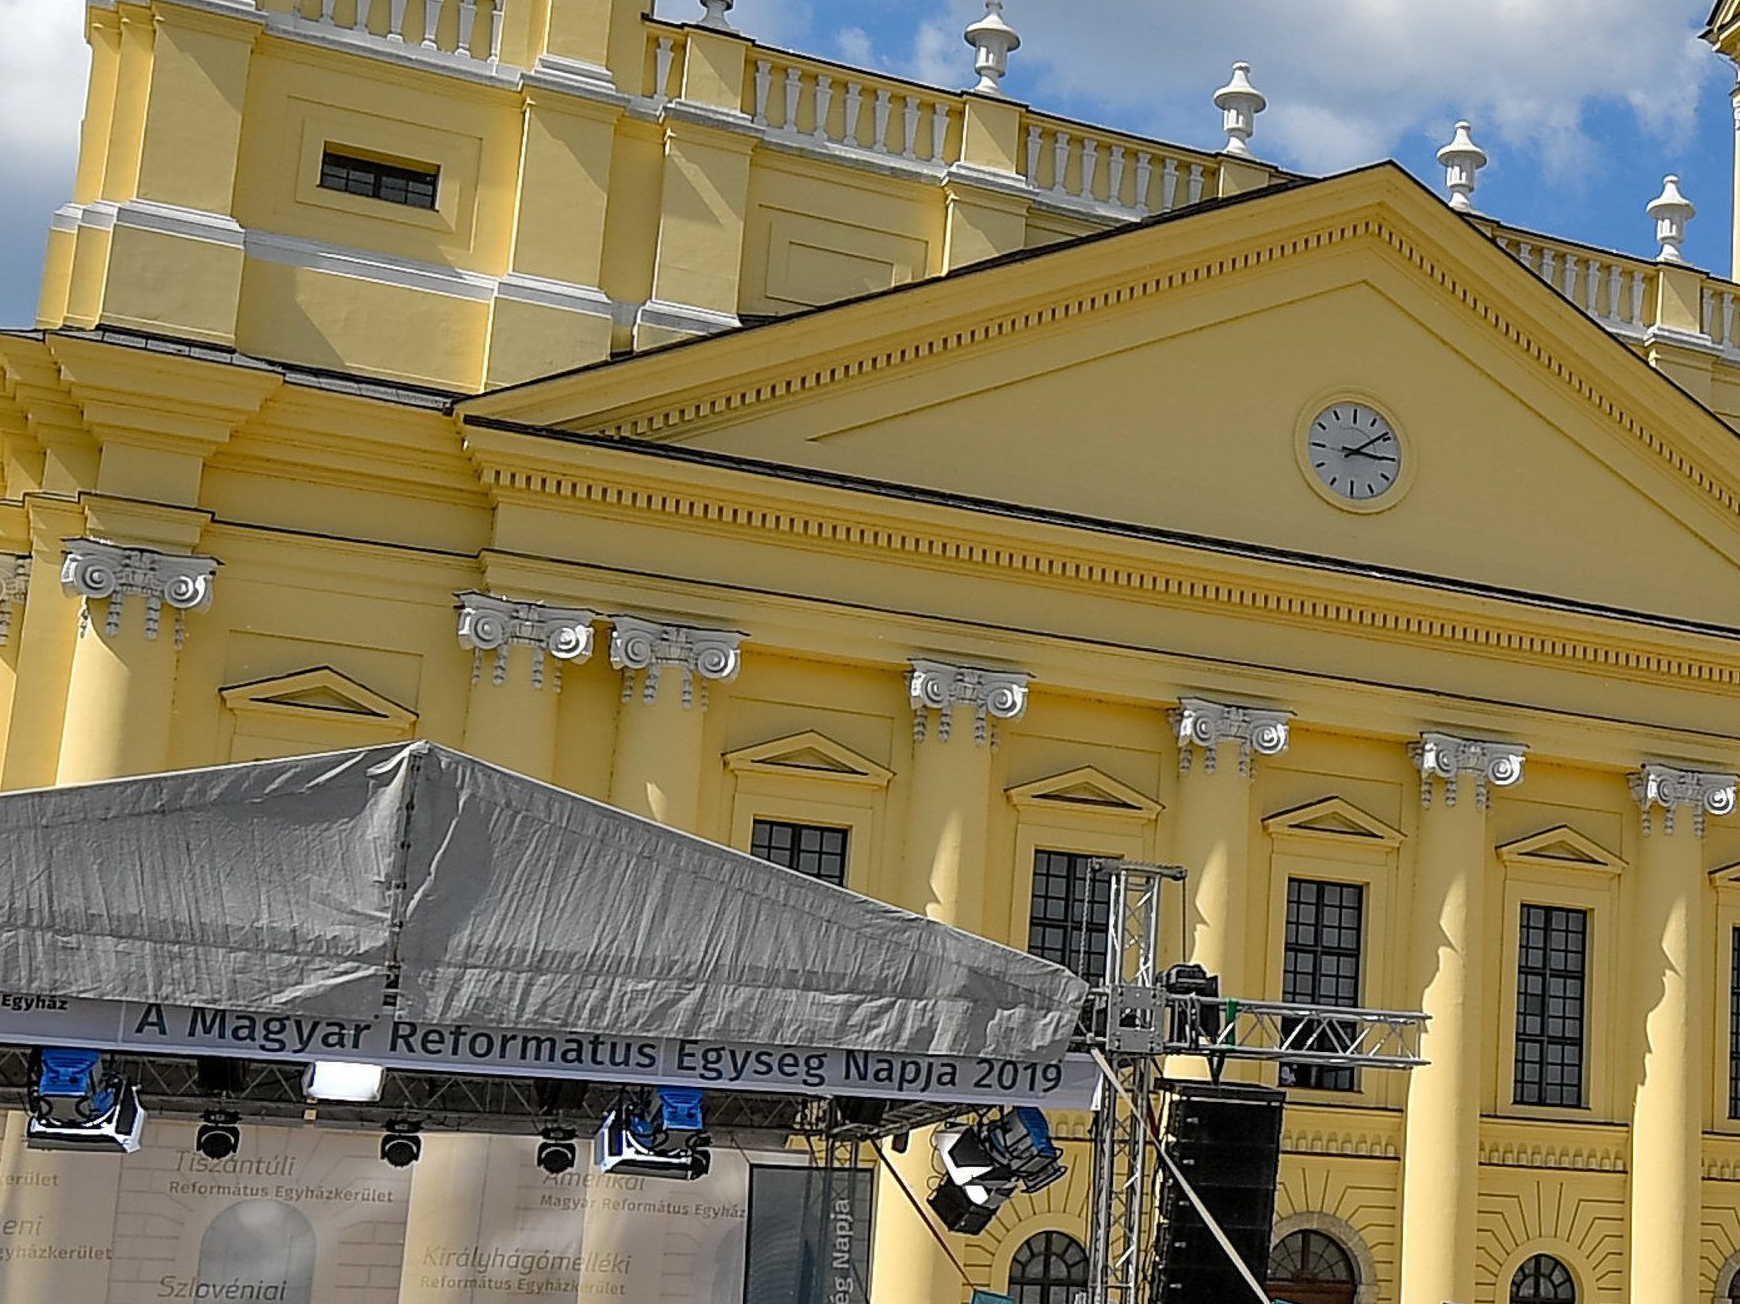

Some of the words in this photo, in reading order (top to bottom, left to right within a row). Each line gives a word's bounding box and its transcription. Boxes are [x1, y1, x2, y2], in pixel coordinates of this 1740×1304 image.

[1, 992, 69, 1012] Egyház
[134, 1006, 168, 1036] A
[186, 1006, 372, 1054] Magyar
[842, 1049, 959, 1094] Napja
[972, 1057, 1063, 1094] 2019
[174, 1149, 296, 1176] Tiszántúli
[168, 1180, 269, 1198] Református
[274, 1184, 394, 1204] Egyházkerület
[539, 1194, 596, 1211] Magyar
[601, 1197, 689, 1216] Református
[694, 1202, 746, 1220] Egyház
[829, 1198, 854, 1269] Napja
[421, 1245, 632, 1276] Királyhágómelléki
[157, 1275, 288, 1301] Szlovéniai
[420, 1274, 512, 1291] Református
[516, 1276, 627, 1296] Egyházkerület
